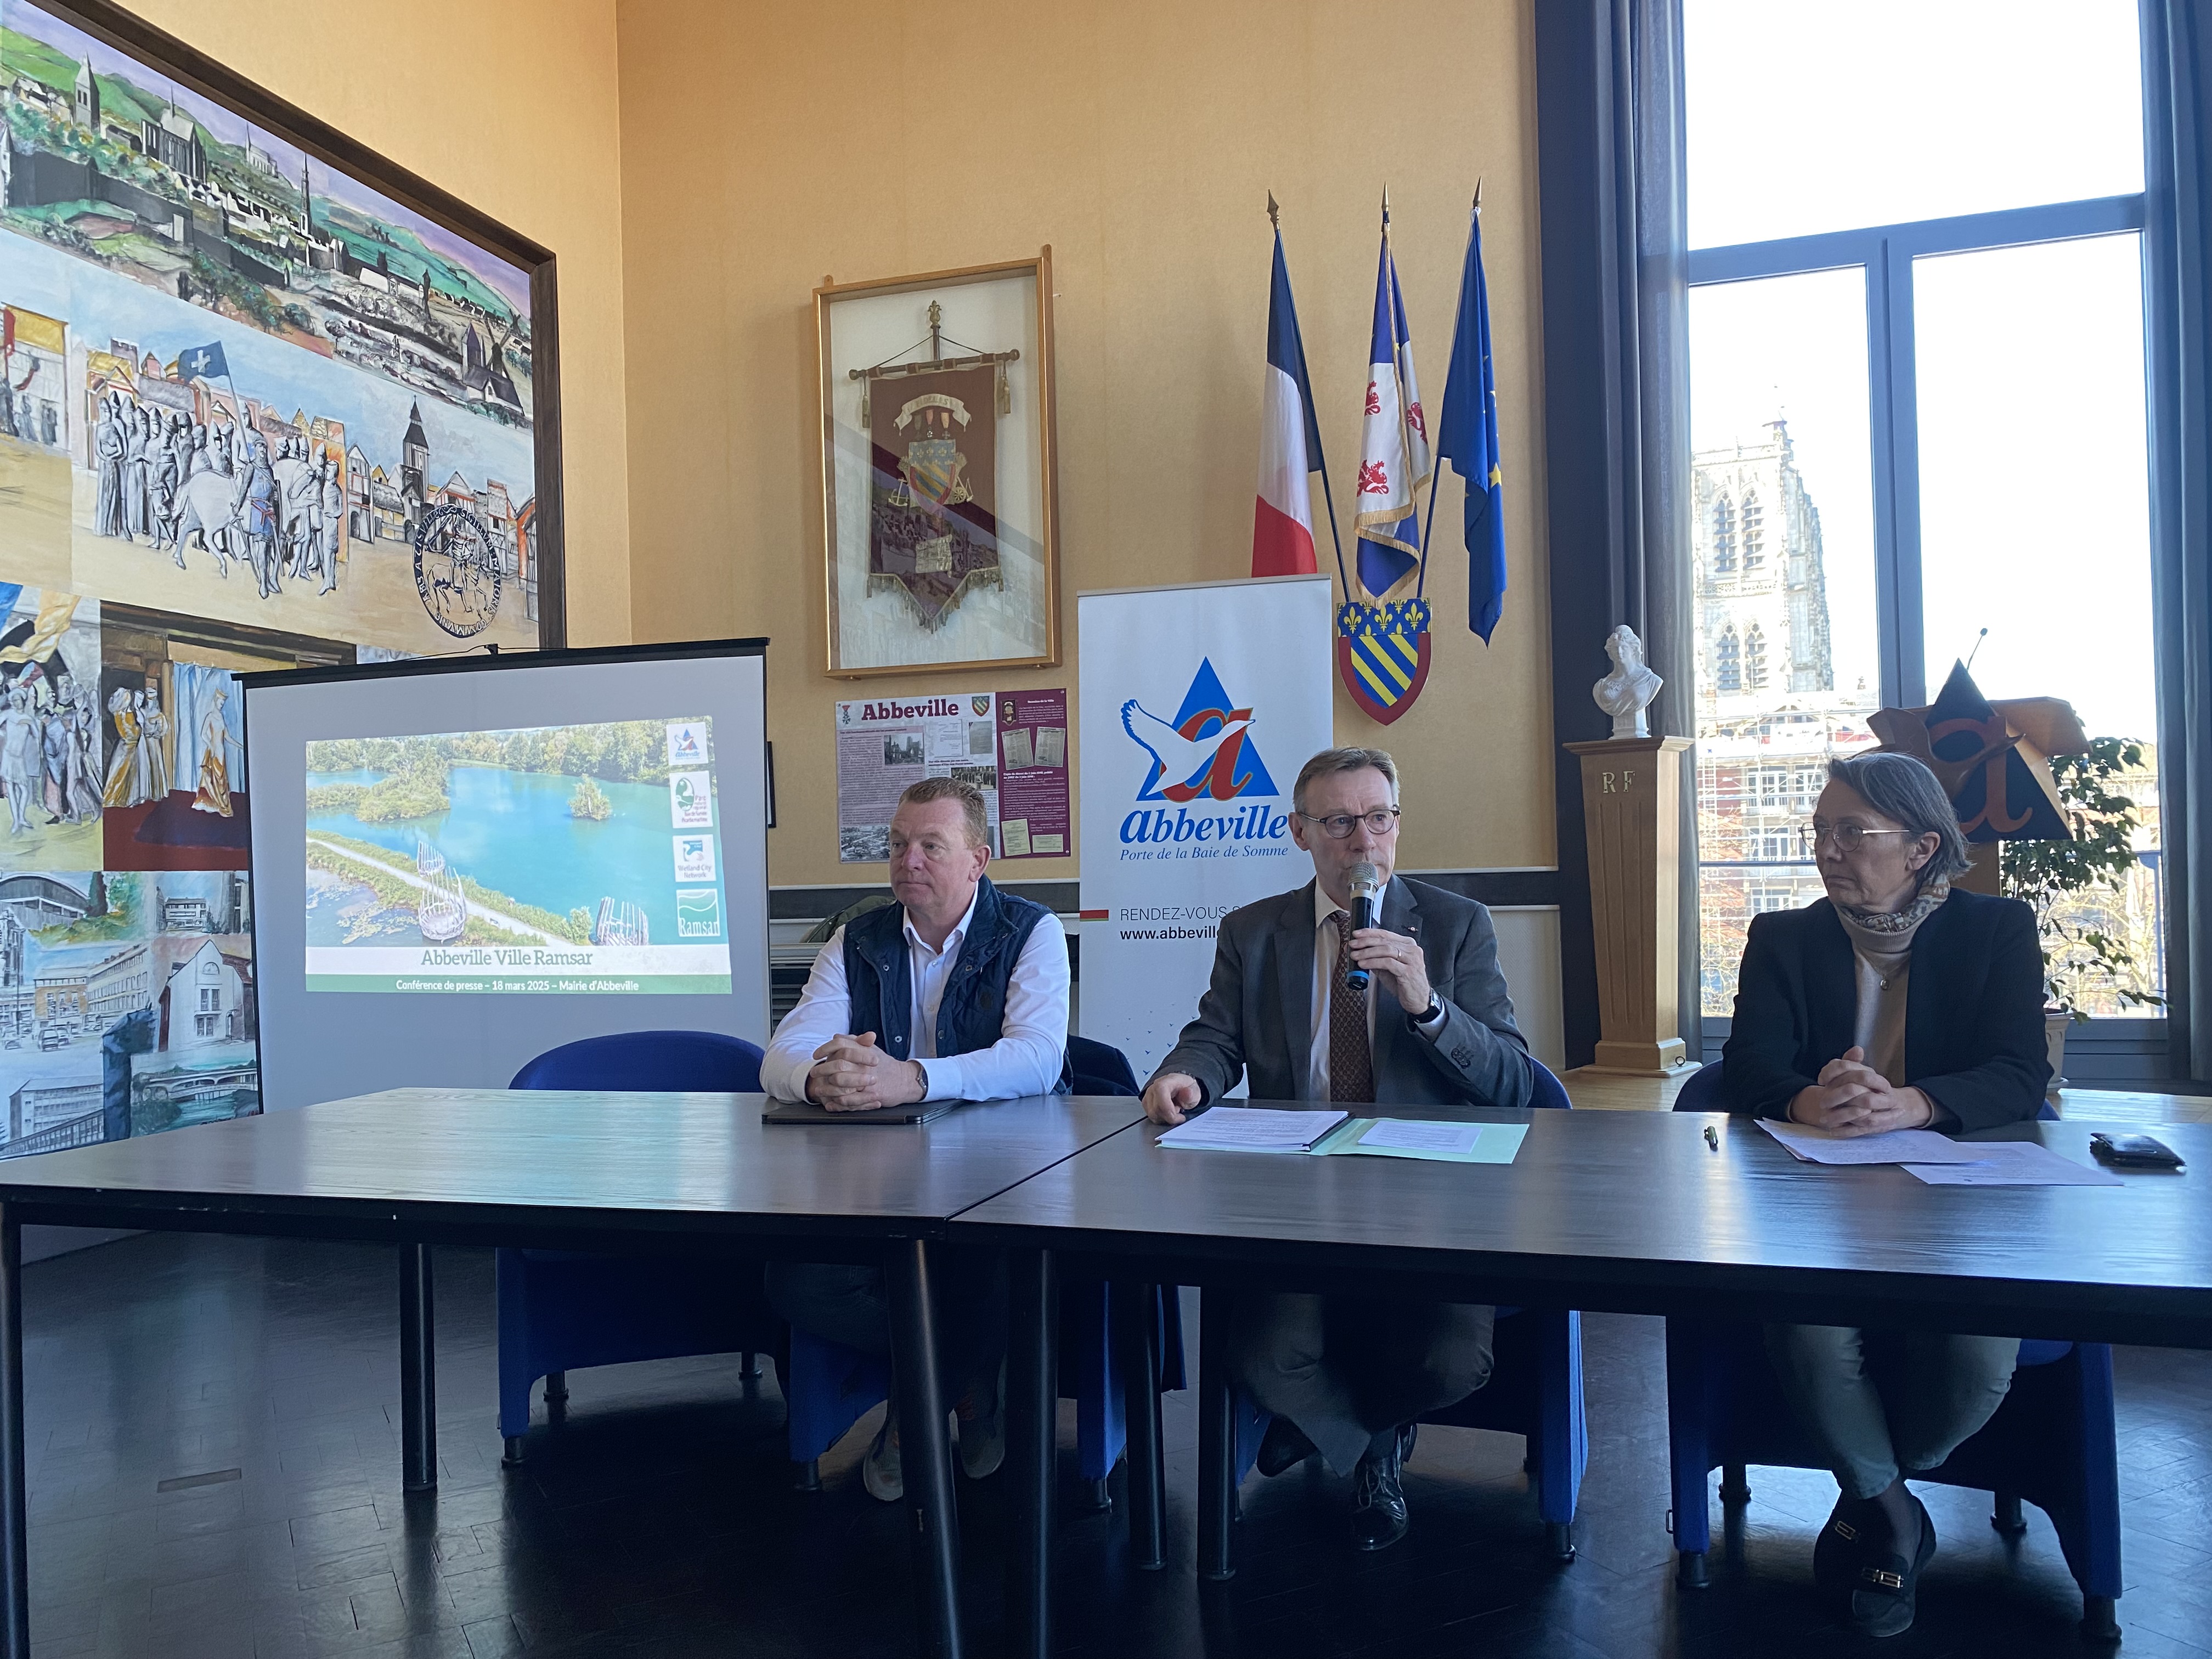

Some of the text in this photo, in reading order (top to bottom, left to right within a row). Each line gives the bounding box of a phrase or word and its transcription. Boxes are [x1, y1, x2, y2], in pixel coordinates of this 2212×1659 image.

[861, 698, 959, 720] Abbeville
[1120, 805, 1288, 844] abbeville
[1120, 845, 1288, 860] Porte de la Baie de Somme
[1120, 906, 1227, 921] RENDEZ-VOUS
[679, 917, 719, 936] Ramsar
[1120, 926, 1219, 940] www.abbevill
[421, 950, 593, 965] Abbeville Ville Ramsar
[396, 980, 443, 990] Conférence
[444, 980, 454, 990] de
[456, 981, 483, 992] presse
[492, 980, 503, 990] 18
[505, 982, 526, 990] mars
[527, 981, 549, 990] 2025
[559, 980, 587, 990] Mairie
[589, 980, 639, 991] d'Abbeville
